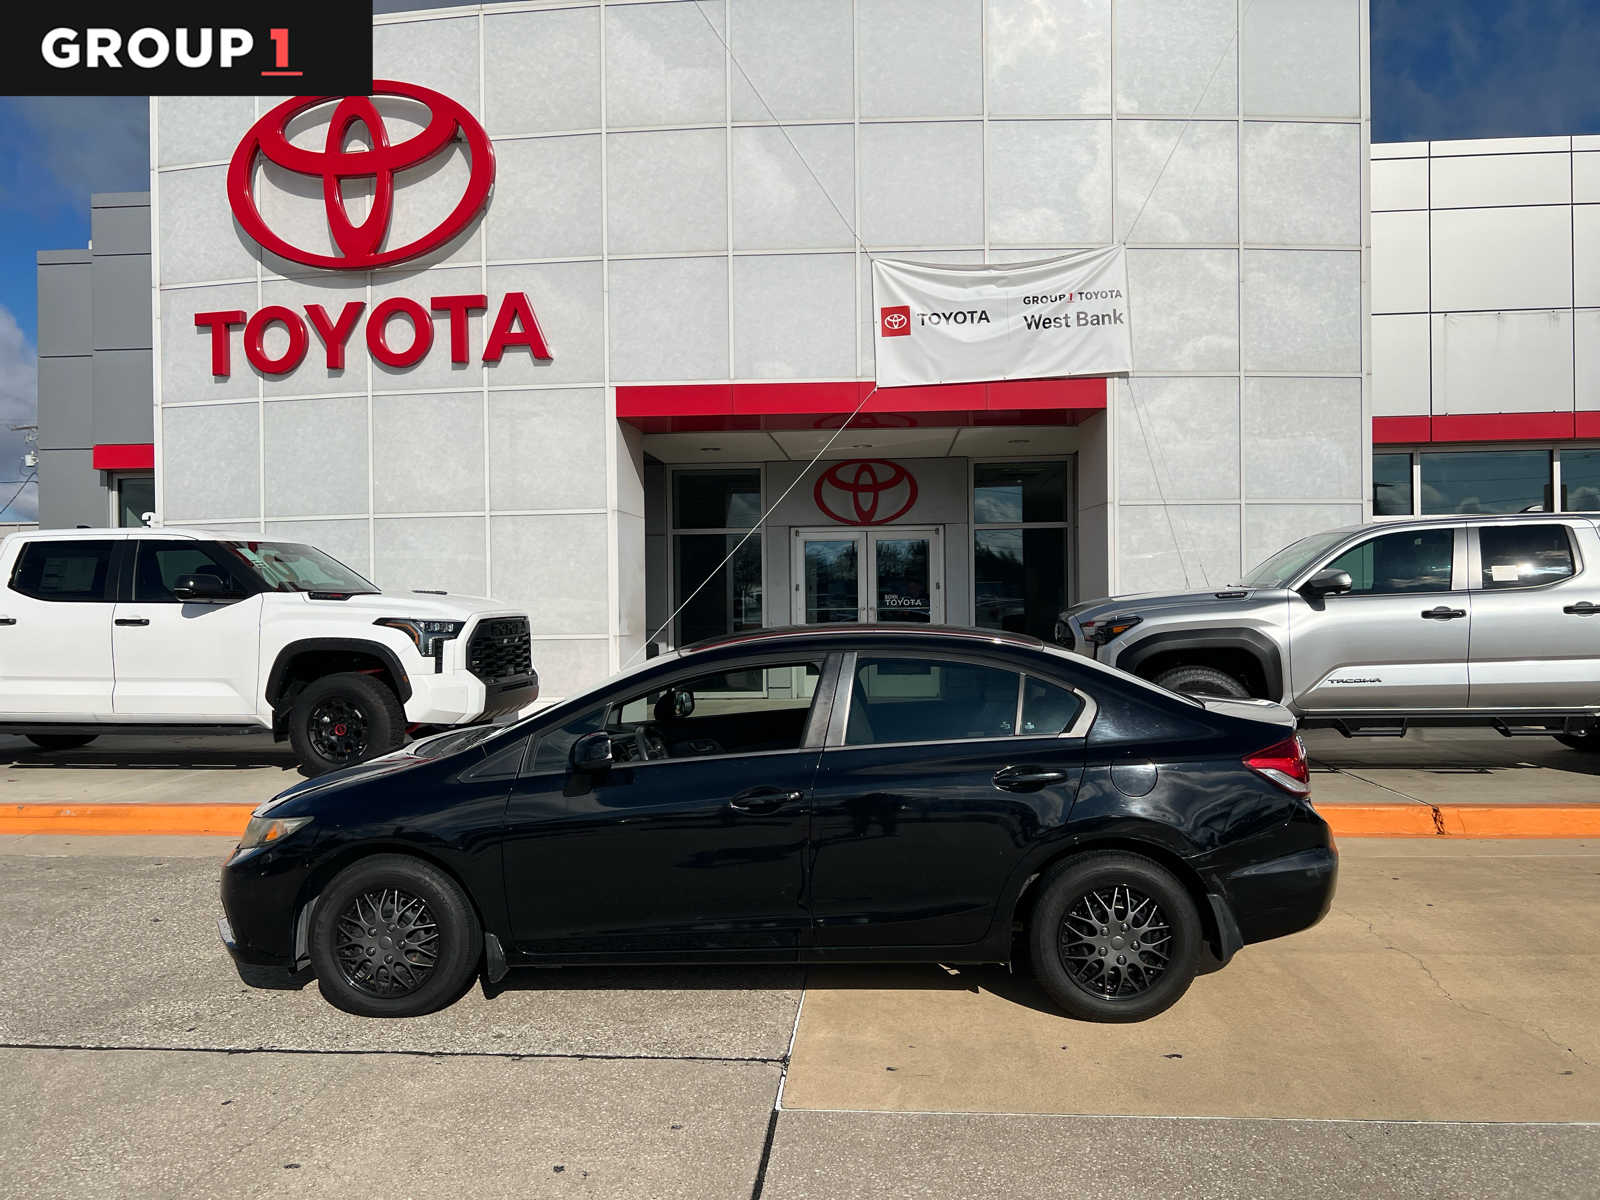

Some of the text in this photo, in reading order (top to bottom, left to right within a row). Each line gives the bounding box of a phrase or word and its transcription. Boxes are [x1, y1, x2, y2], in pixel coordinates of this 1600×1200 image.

[1023, 294, 1066, 305] GROUP
[1078, 290, 1122, 301] TOYOTA
[917, 310, 991, 326] TOYOTA
[1024, 309, 1124, 330] West Bank
[195, 292, 553, 377] TOYOTA
